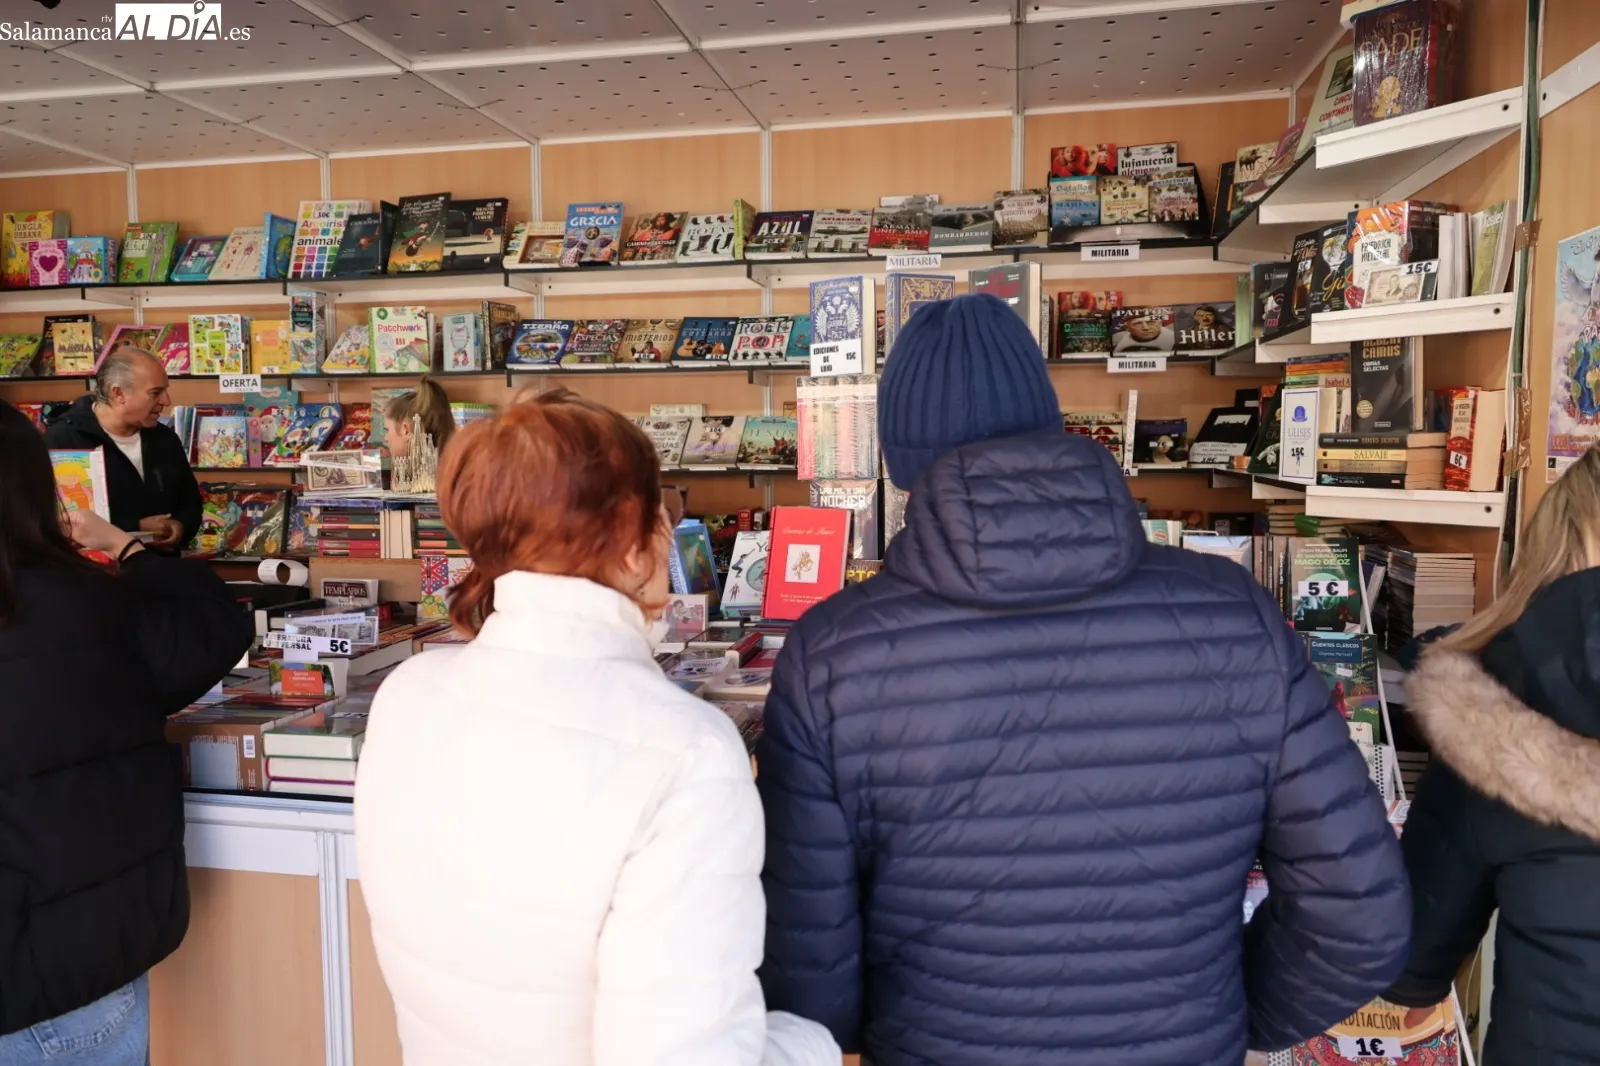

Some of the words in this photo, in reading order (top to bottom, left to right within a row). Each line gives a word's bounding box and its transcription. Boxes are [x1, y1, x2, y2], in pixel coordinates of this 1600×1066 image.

[757, 220, 802, 236] AZUL
[1091, 249, 1130, 257] MILITARIA
[890, 257, 939, 267] MILITARIA
[1407, 262, 1433, 275] 15€
[377, 324, 422, 333] Patchwork
[1118, 361, 1157, 370] MILITARIA
[222, 378, 259, 388] OFERTA
[1354, 449, 1389, 459] SALVAJE
[1294, 558, 1322, 566] MAGO
[265, 633, 312, 644] LERATURA
[329, 639, 349, 653] 5€
[265, 639, 312, 651] UIVERSAL
[1340, 1011, 1401, 1031] DITACIÓN
[1356, 1038, 1385, 1057] 1€
